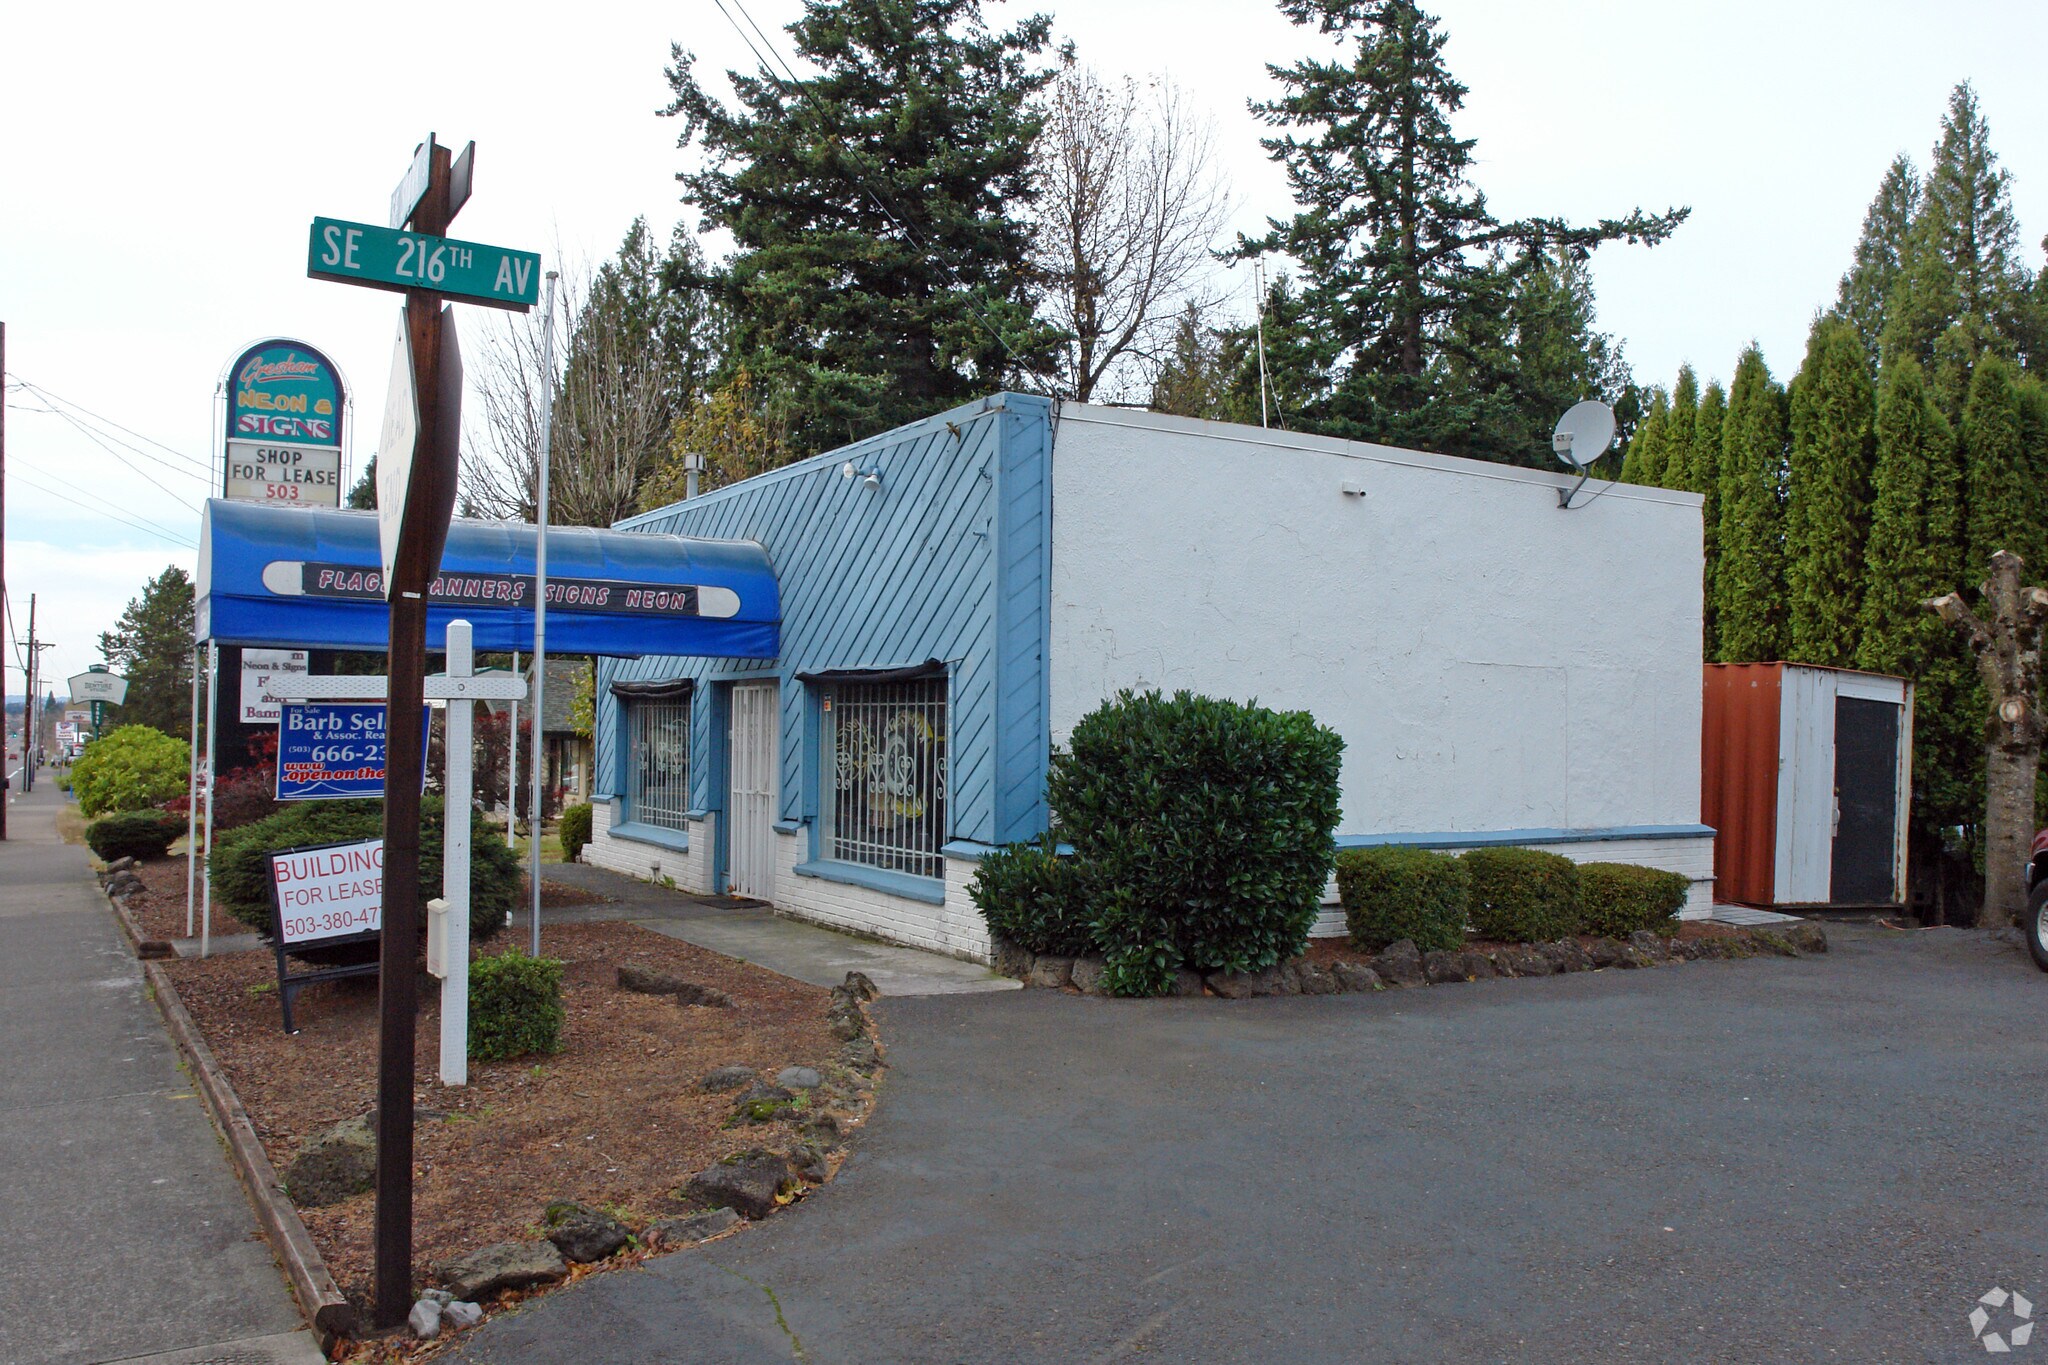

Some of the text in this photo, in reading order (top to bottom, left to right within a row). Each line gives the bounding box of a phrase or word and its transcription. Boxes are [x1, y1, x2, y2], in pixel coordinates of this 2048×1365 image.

[322, 225, 363, 270] SE
[493, 256, 532, 295] AV
[240, 353, 318, 389] Gresham
[238, 389, 332, 415] NEON &
[237, 413, 332, 439] SIGNS
[256, 449, 302, 465] SHOP
[233, 464, 335, 485] FOR LEASE
[266, 484, 299, 500] 503
[318, 570, 686, 611] FLAG ANNERS SIGNS NEON
[243, 661, 307, 673] Neon & Signs
[289, 712, 386, 731] Barb Sel
[313, 731, 323, 740] &
[325, 731, 361, 740] Assoc.
[288, 746, 311, 754] (503)
[284, 762, 325, 772] www
[284, 878, 382, 908] FOR LEASE
[285, 906, 381, 937] 503-380-47
